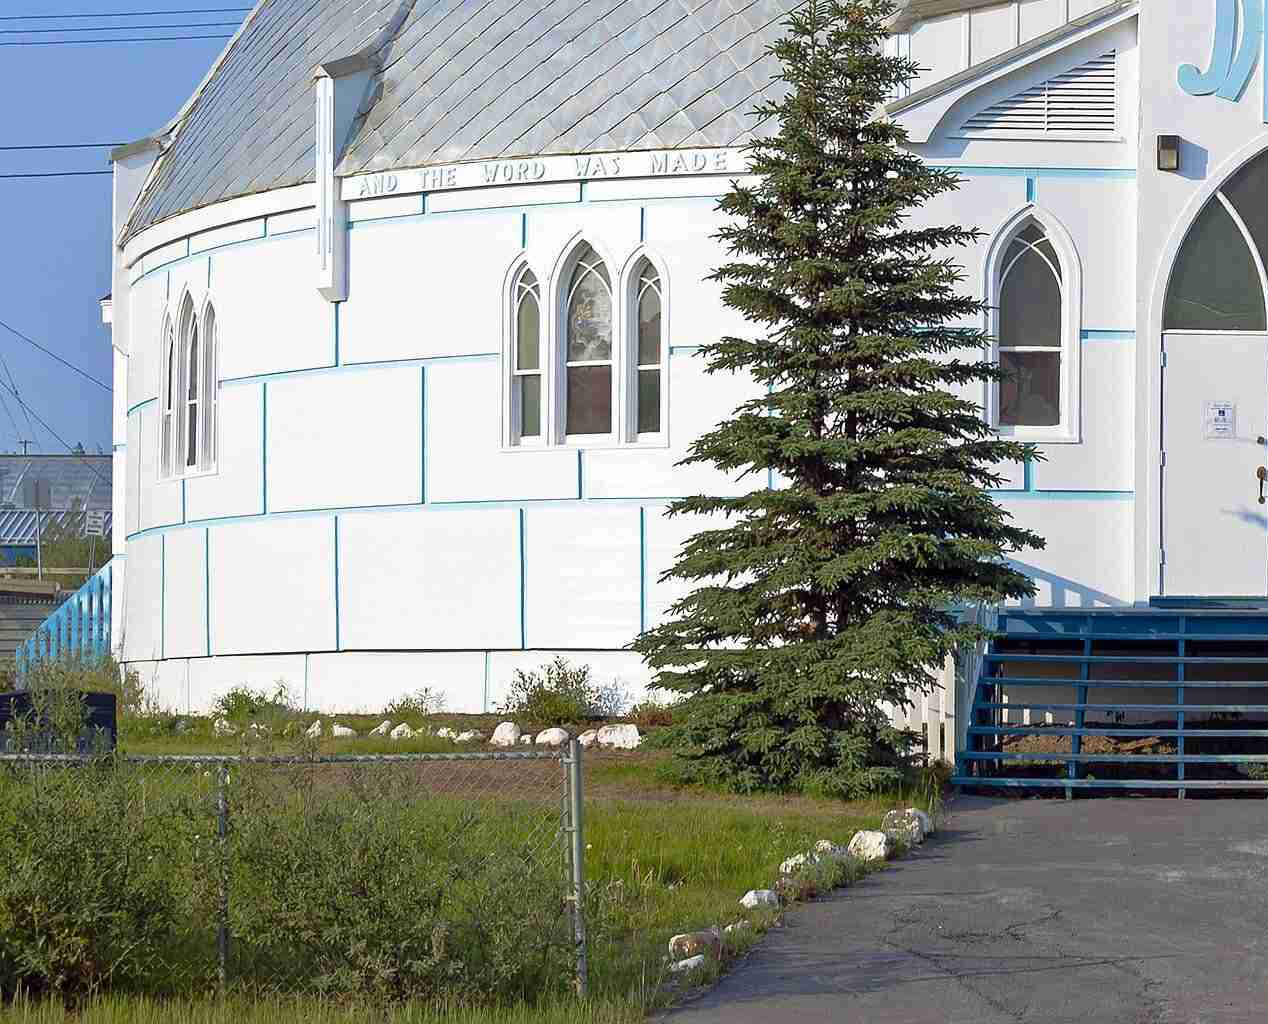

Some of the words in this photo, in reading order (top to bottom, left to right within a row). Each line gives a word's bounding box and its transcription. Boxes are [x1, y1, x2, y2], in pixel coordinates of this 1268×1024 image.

[360, 176, 398, 196] AND
[417, 168, 457, 189] THE
[482, 160, 546, 183] WORD
[575, 157, 621, 177] WAS
[650, 151, 728, 174] MADE
